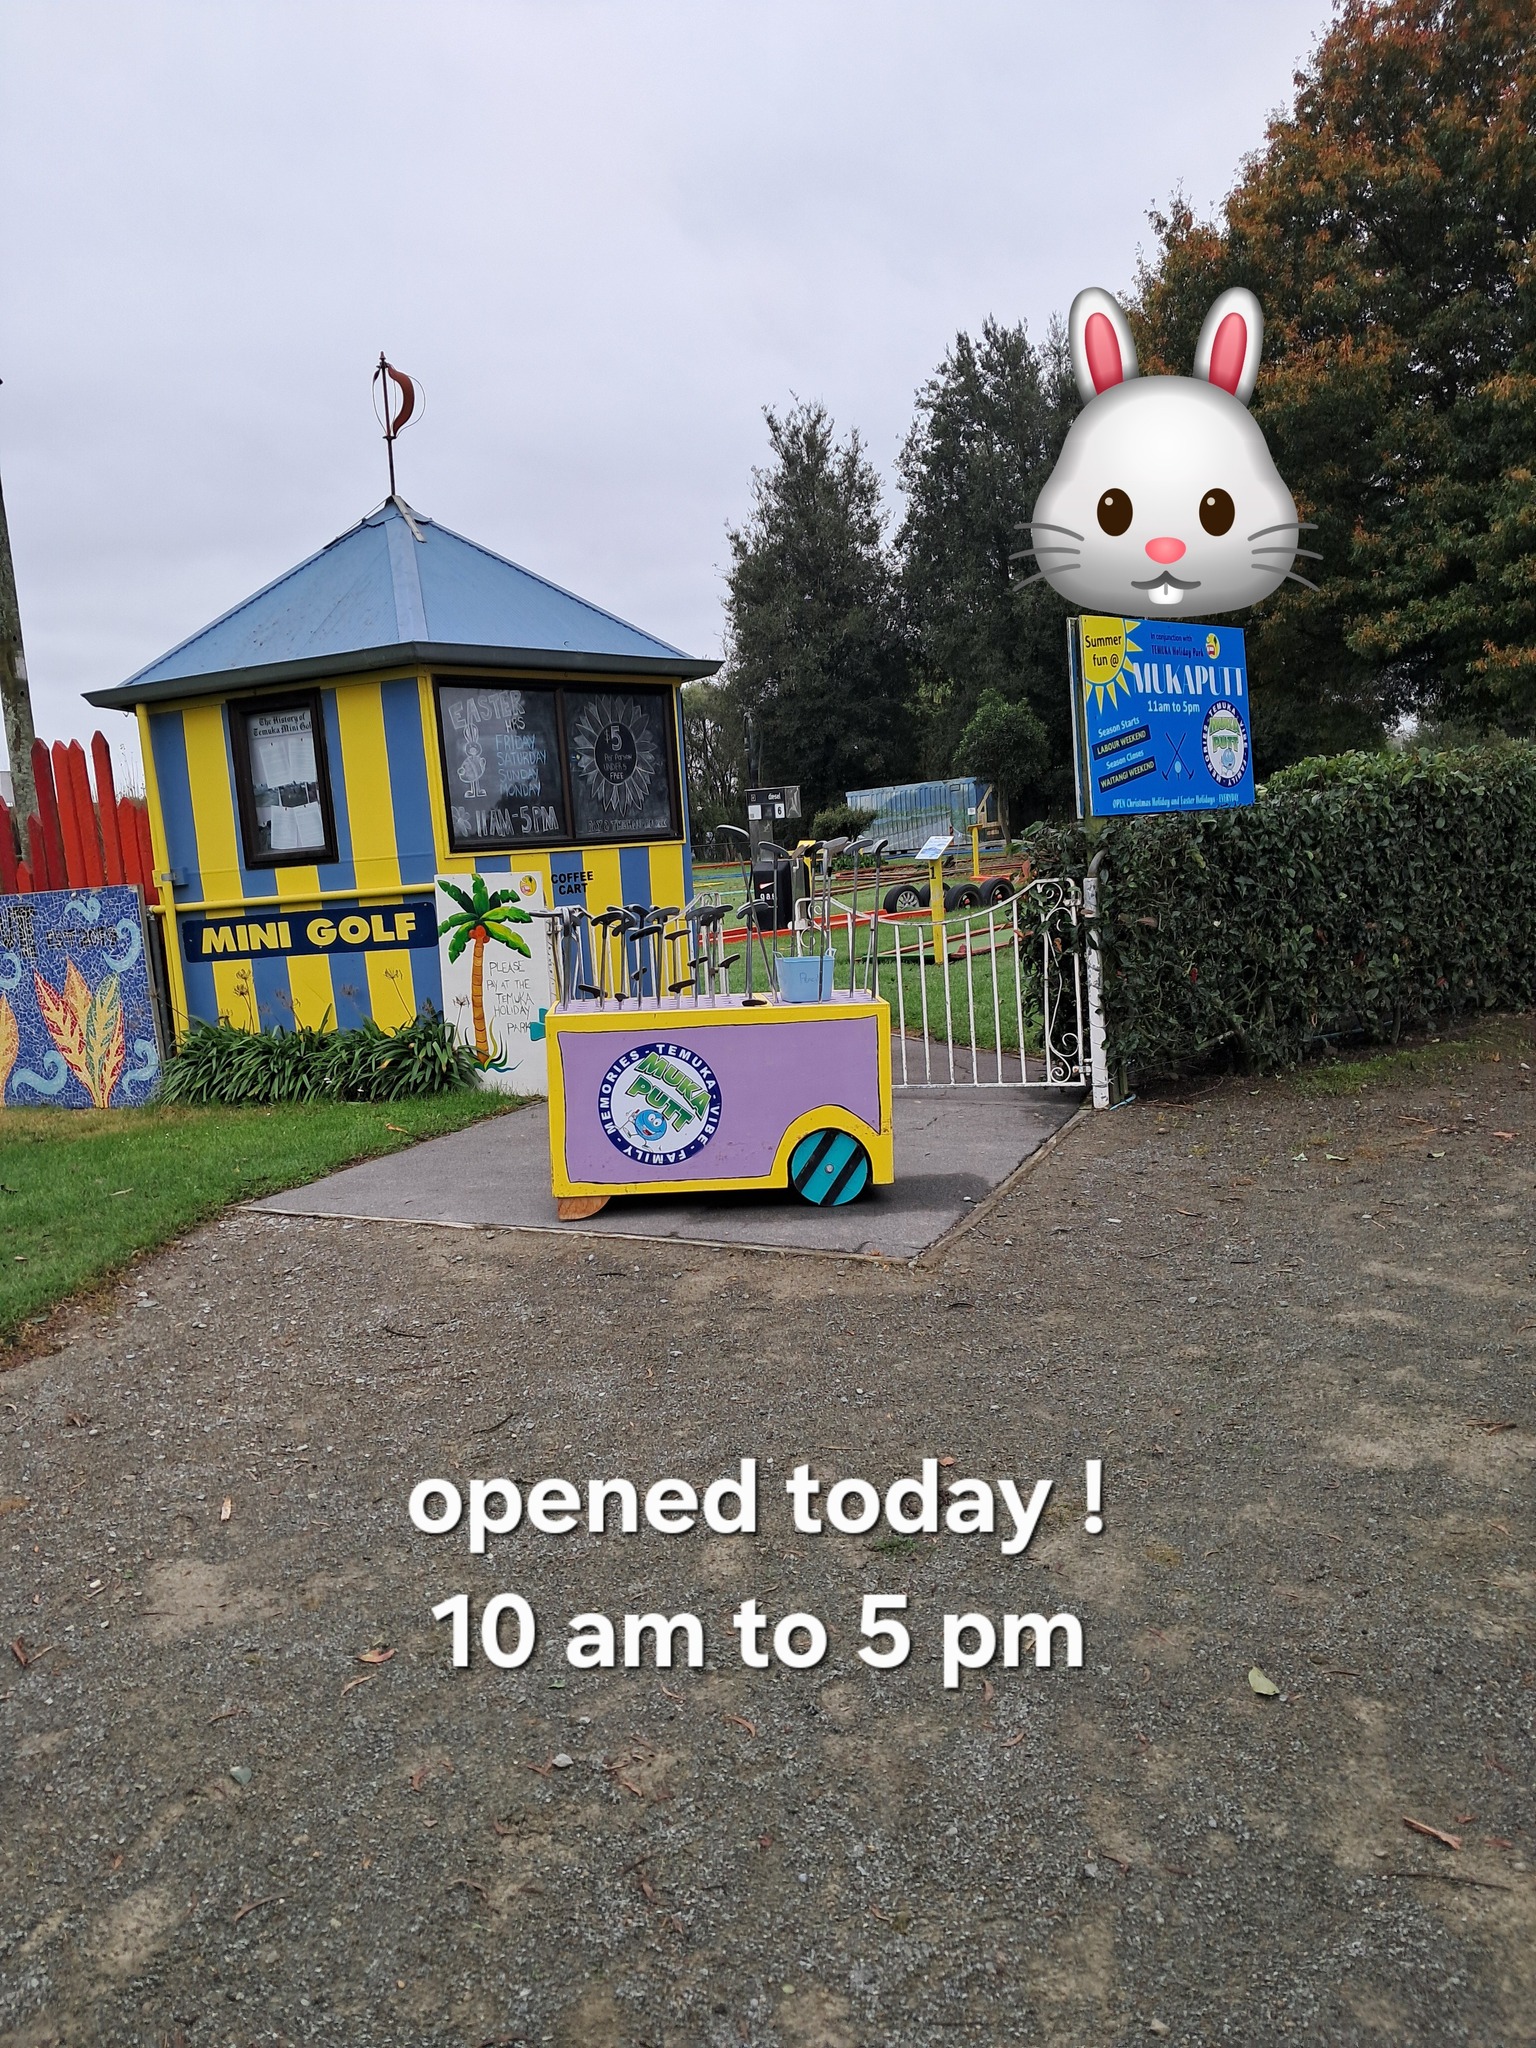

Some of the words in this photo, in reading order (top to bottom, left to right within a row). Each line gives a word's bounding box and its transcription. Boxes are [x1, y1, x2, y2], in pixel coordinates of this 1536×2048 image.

[1085, 635, 1122, 648] Summer
[1093, 654, 1108, 667] fun
[1110, 654, 1119, 668] @
[1132, 662, 1244, 697] MUKAPUTT
[448, 690, 526, 730] EASTER
[1148, 700, 1171, 712] 11am
[1172, 702, 1181, 713] to
[1183, 701, 1201, 716] 5pm
[1209, 701, 1236, 716] TEMUKA
[259, 717, 271, 726] The
[273, 715, 298, 724] History
[298, 712, 305, 720] of
[505, 716, 526, 733] HRS
[1209, 717, 1241, 737] MUKA
[253, 726, 281, 736] Temuka
[281, 724, 299, 733] Mini
[300, 721, 311, 730] Gol
[1098, 724, 1120, 738] Season
[1120, 717, 1140, 730] Starts
[495, 734, 536, 751] FRIDAY
[1097, 740, 1120, 755] LABOUR
[1120, 730, 1147, 746] WEEKEND
[1212, 735, 1239, 753] PUTT
[496, 750, 548, 766] SATURDAY
[1106, 757, 1126, 770] Season
[1126, 750, 1144, 762] Closes
[498, 768, 539, 783] SUNDAY
[610, 771, 624, 780] FREE
[1100, 771, 1129, 788] WAITANGI
[1128, 761, 1155, 777] WEEKEND
[499, 782, 541, 797] MONDAY
[778, 806, 782, 815] 6
[1112, 799, 1126, 809] OPEN
[1126, 798, 1151, 808] Christmas
[1171, 796, 1180, 806] and
[551, 871, 594, 885] COFFEE
[930, 866, 936, 880] 1
[558, 883, 588, 895] CART
[202, 921, 292, 954] MINI
[307, 912, 416, 946] GOLF
[489, 960, 525, 976] PLEASE
[487, 980, 498, 992] PAY
[501, 980, 510, 990] AT
[514, 978, 531, 990] THE
[496, 992, 534, 1006] TEMUKA
[494, 1005, 530, 1020] HOLIDAY
[656, 1044, 716, 1090] TEMUKA
[600, 1050, 640, 1135] MEMORIES
[634, 1051, 712, 1121] MUKA
[625, 1074, 695, 1132] PUTT
[697, 1105, 720, 1145] VIBE
[622, 1145, 687, 1164] FAMILY
